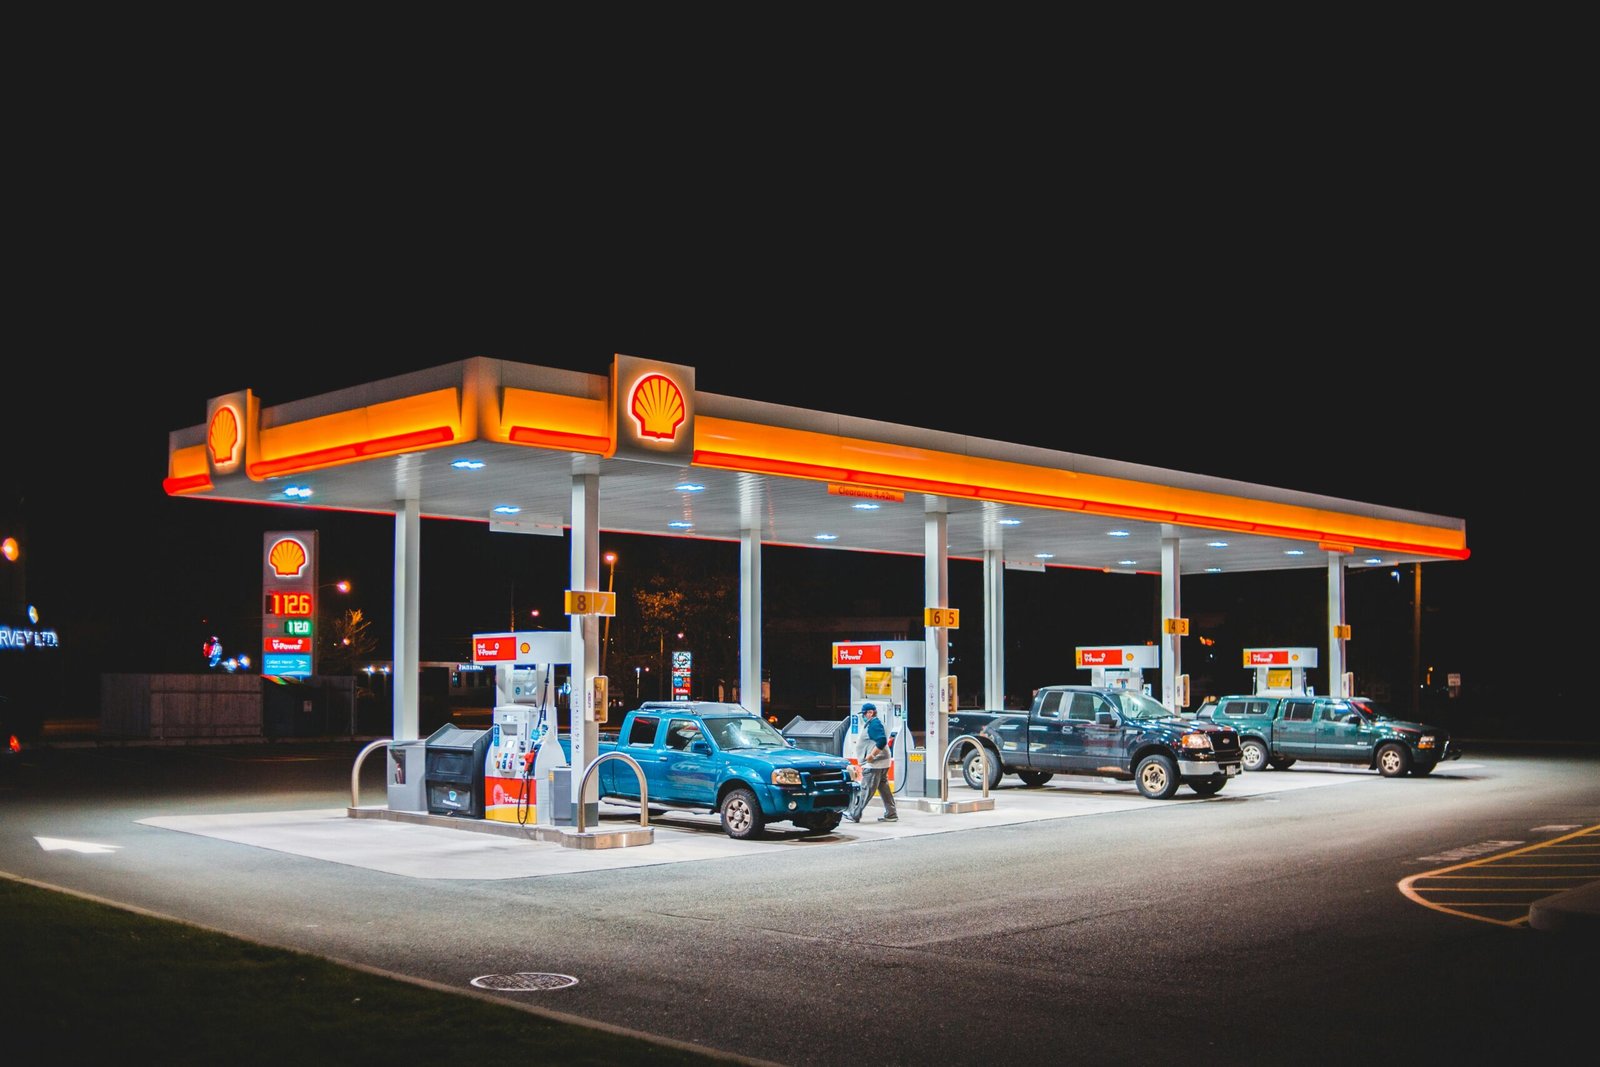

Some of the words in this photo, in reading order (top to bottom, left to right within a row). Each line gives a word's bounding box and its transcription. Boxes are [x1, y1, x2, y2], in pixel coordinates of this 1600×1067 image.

[838, 486, 873, 499] Clearance
[577, 595, 586, 611] 8
[600, 596, 608, 613] 7
[934, 611, 941, 625] 6
[948, 612, 955, 625] 5
[1171, 621, 1176, 633] 4
[1181, 621, 1186, 633] 3
[0, 630, 33, 646] RVEY
